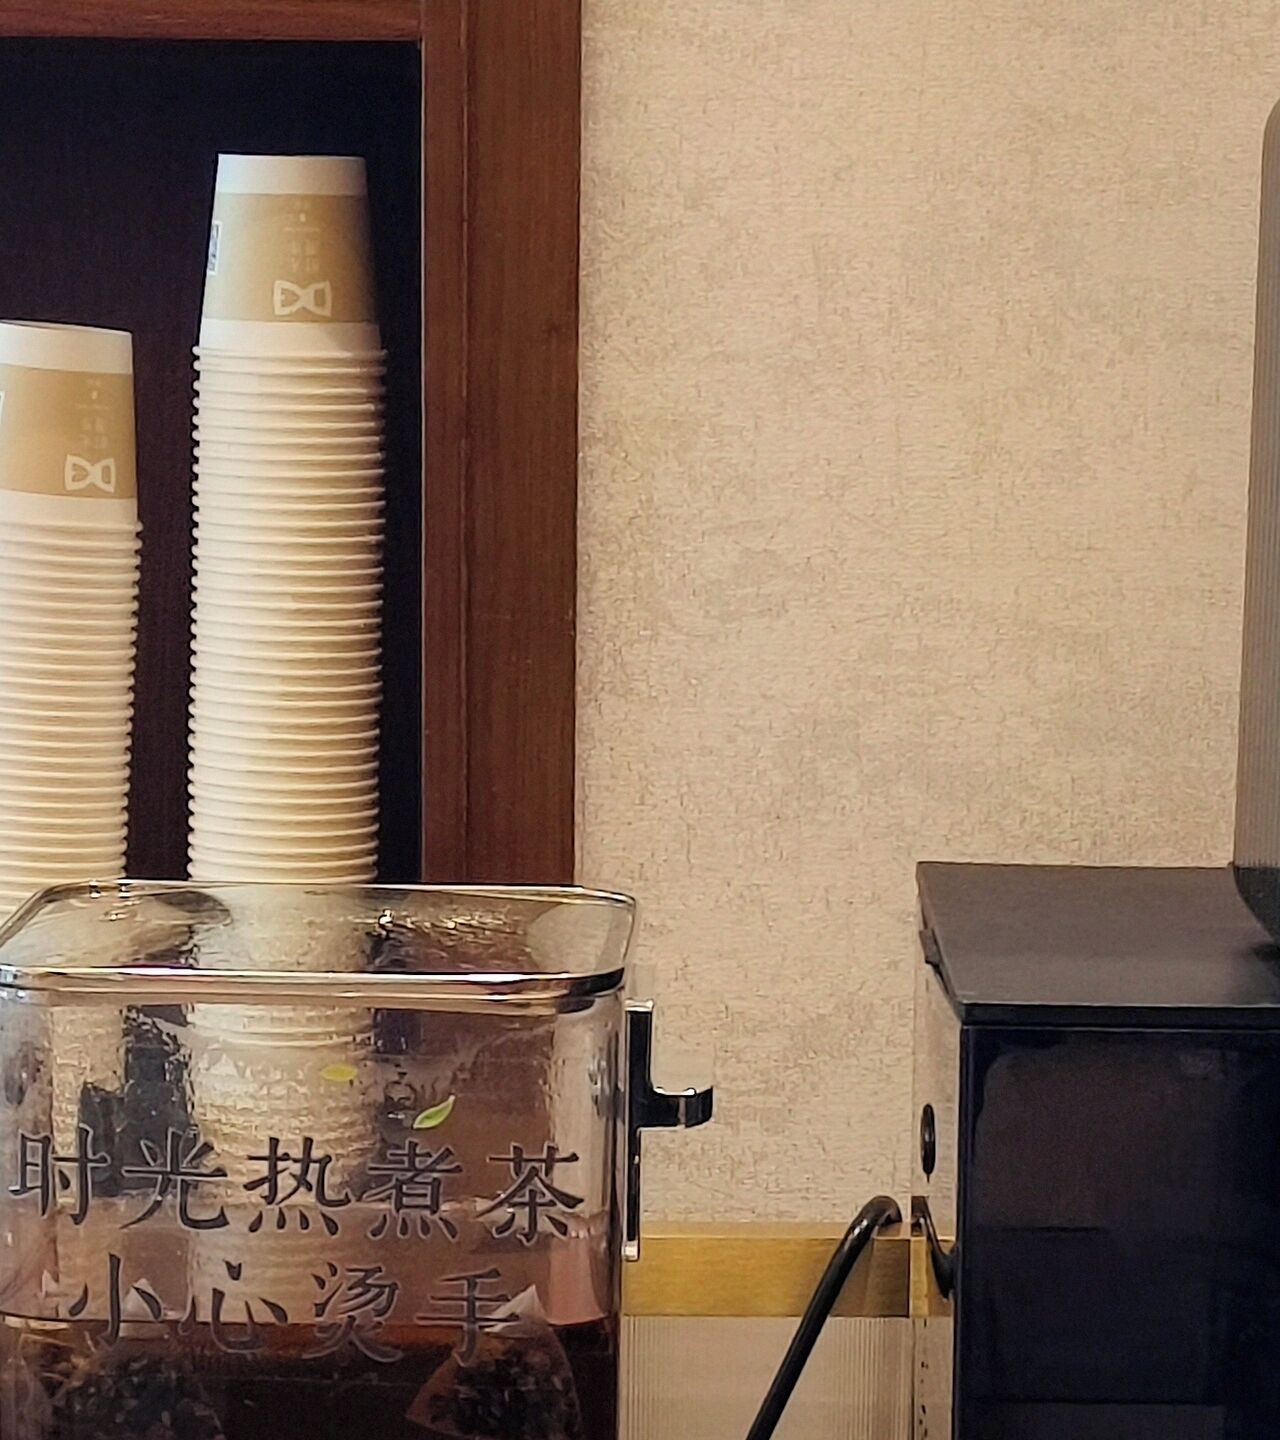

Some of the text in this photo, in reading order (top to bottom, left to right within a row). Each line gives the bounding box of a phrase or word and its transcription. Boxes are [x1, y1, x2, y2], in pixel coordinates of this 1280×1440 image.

[9, 1124, 585, 1246] 时光热煮茶
[68, 1252, 521, 1368] 小心烫手
